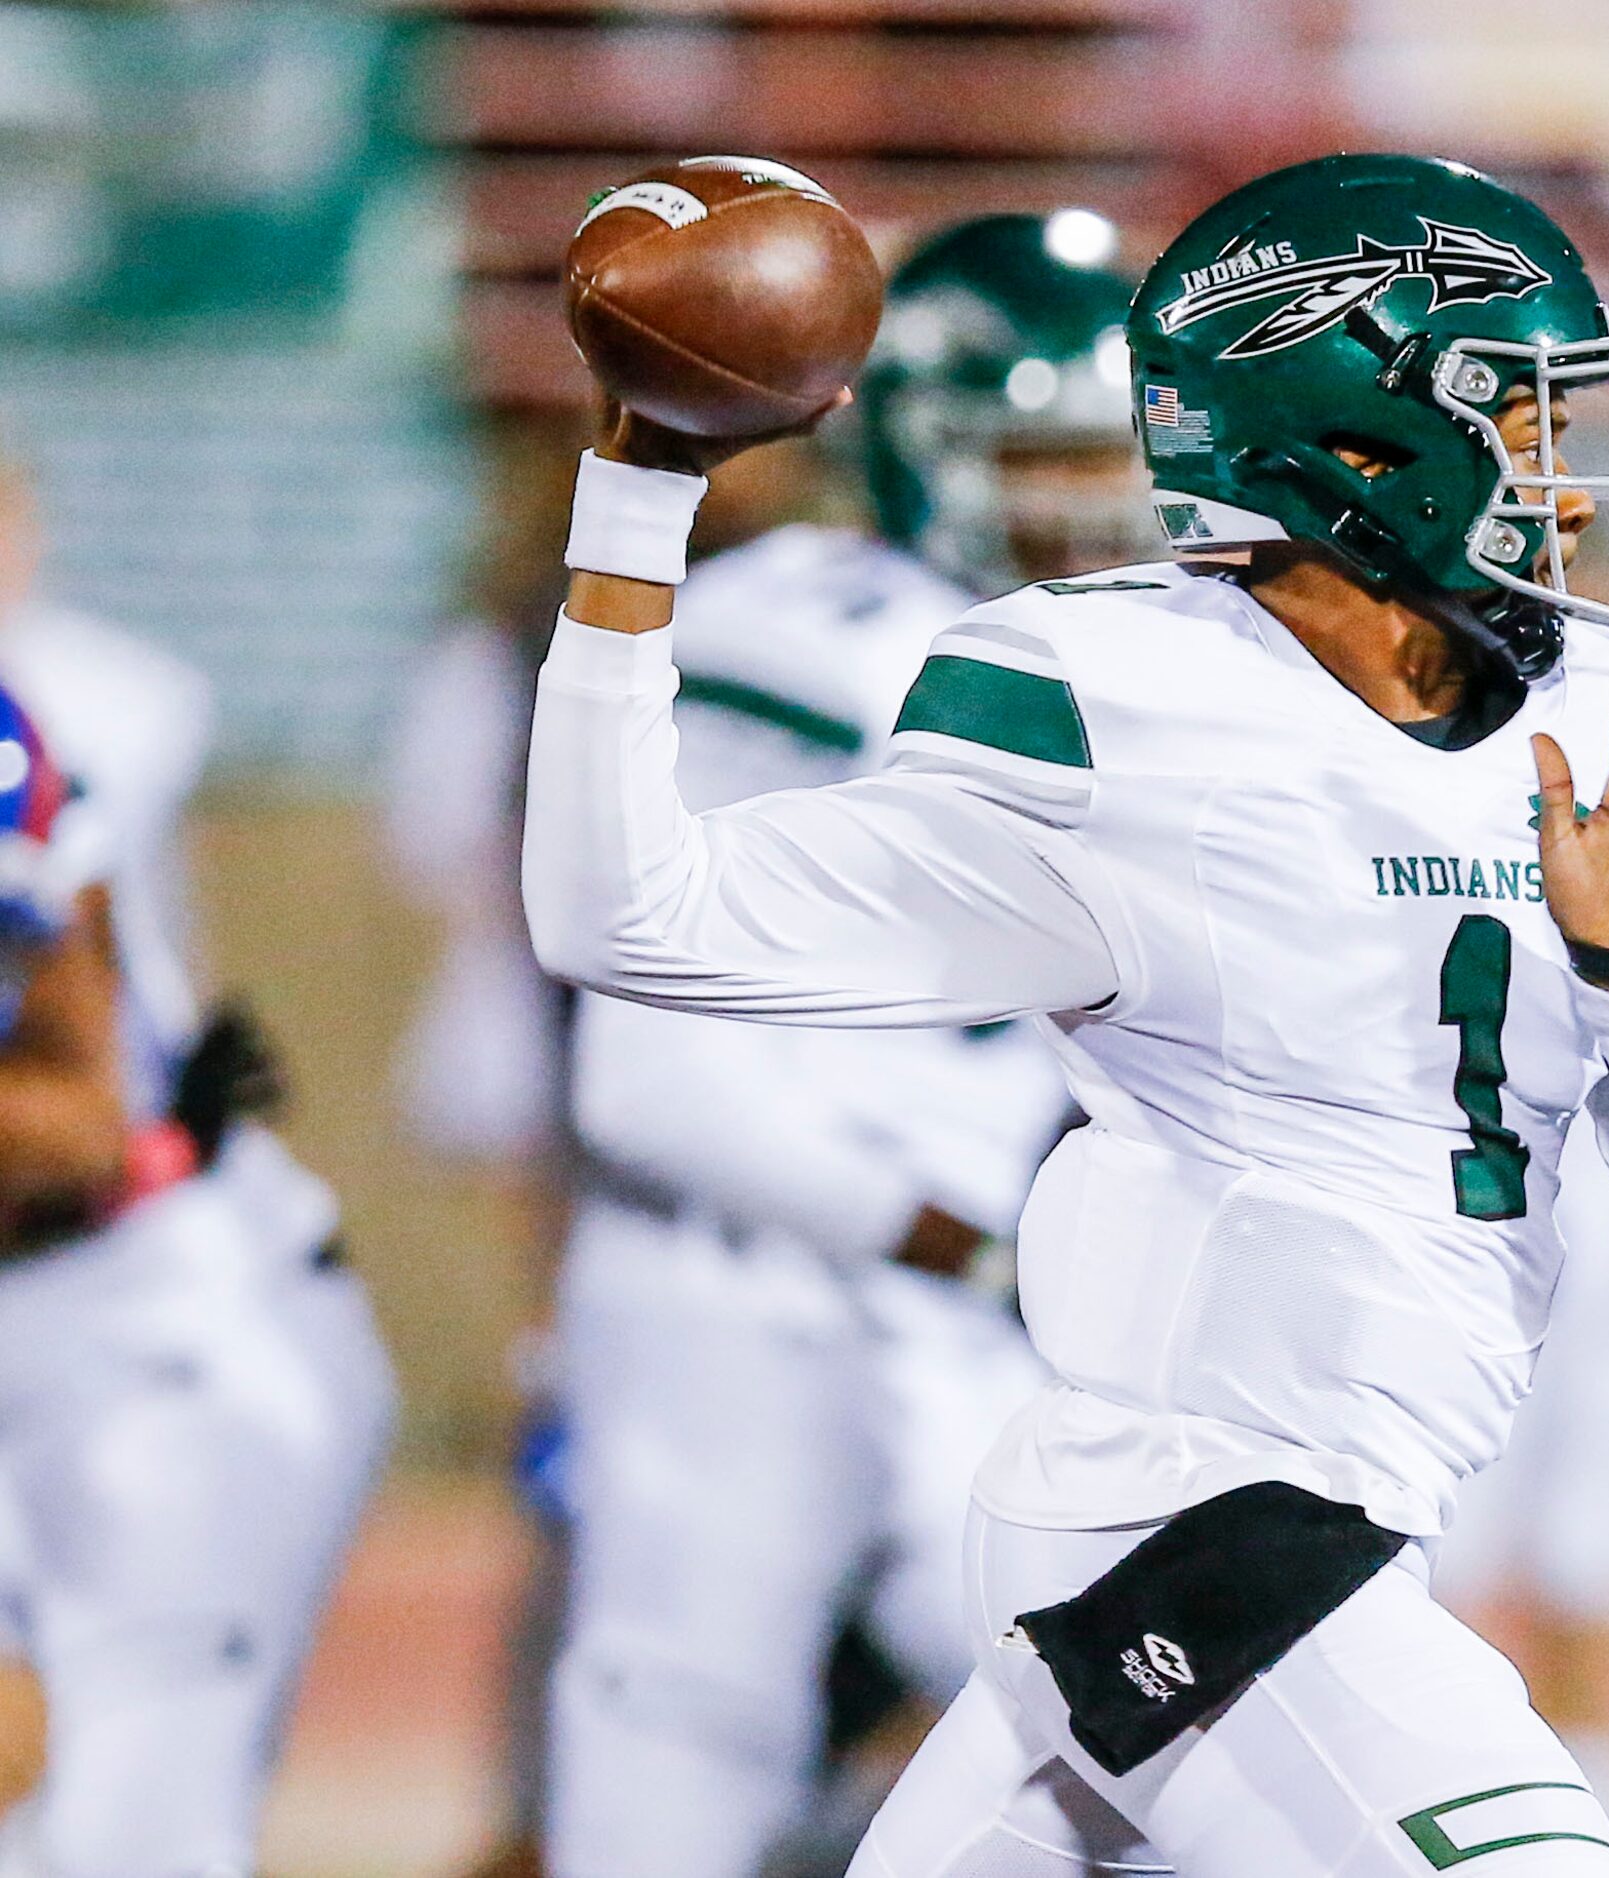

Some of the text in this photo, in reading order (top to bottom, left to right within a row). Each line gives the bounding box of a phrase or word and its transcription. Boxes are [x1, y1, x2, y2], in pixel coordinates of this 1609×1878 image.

[1180, 240, 1298, 295] INDIANS
[1371, 856, 1546, 903] INDIANS
[1438, 913, 1531, 1222] 1
[1119, 1647, 1177, 1703] SHOCK
